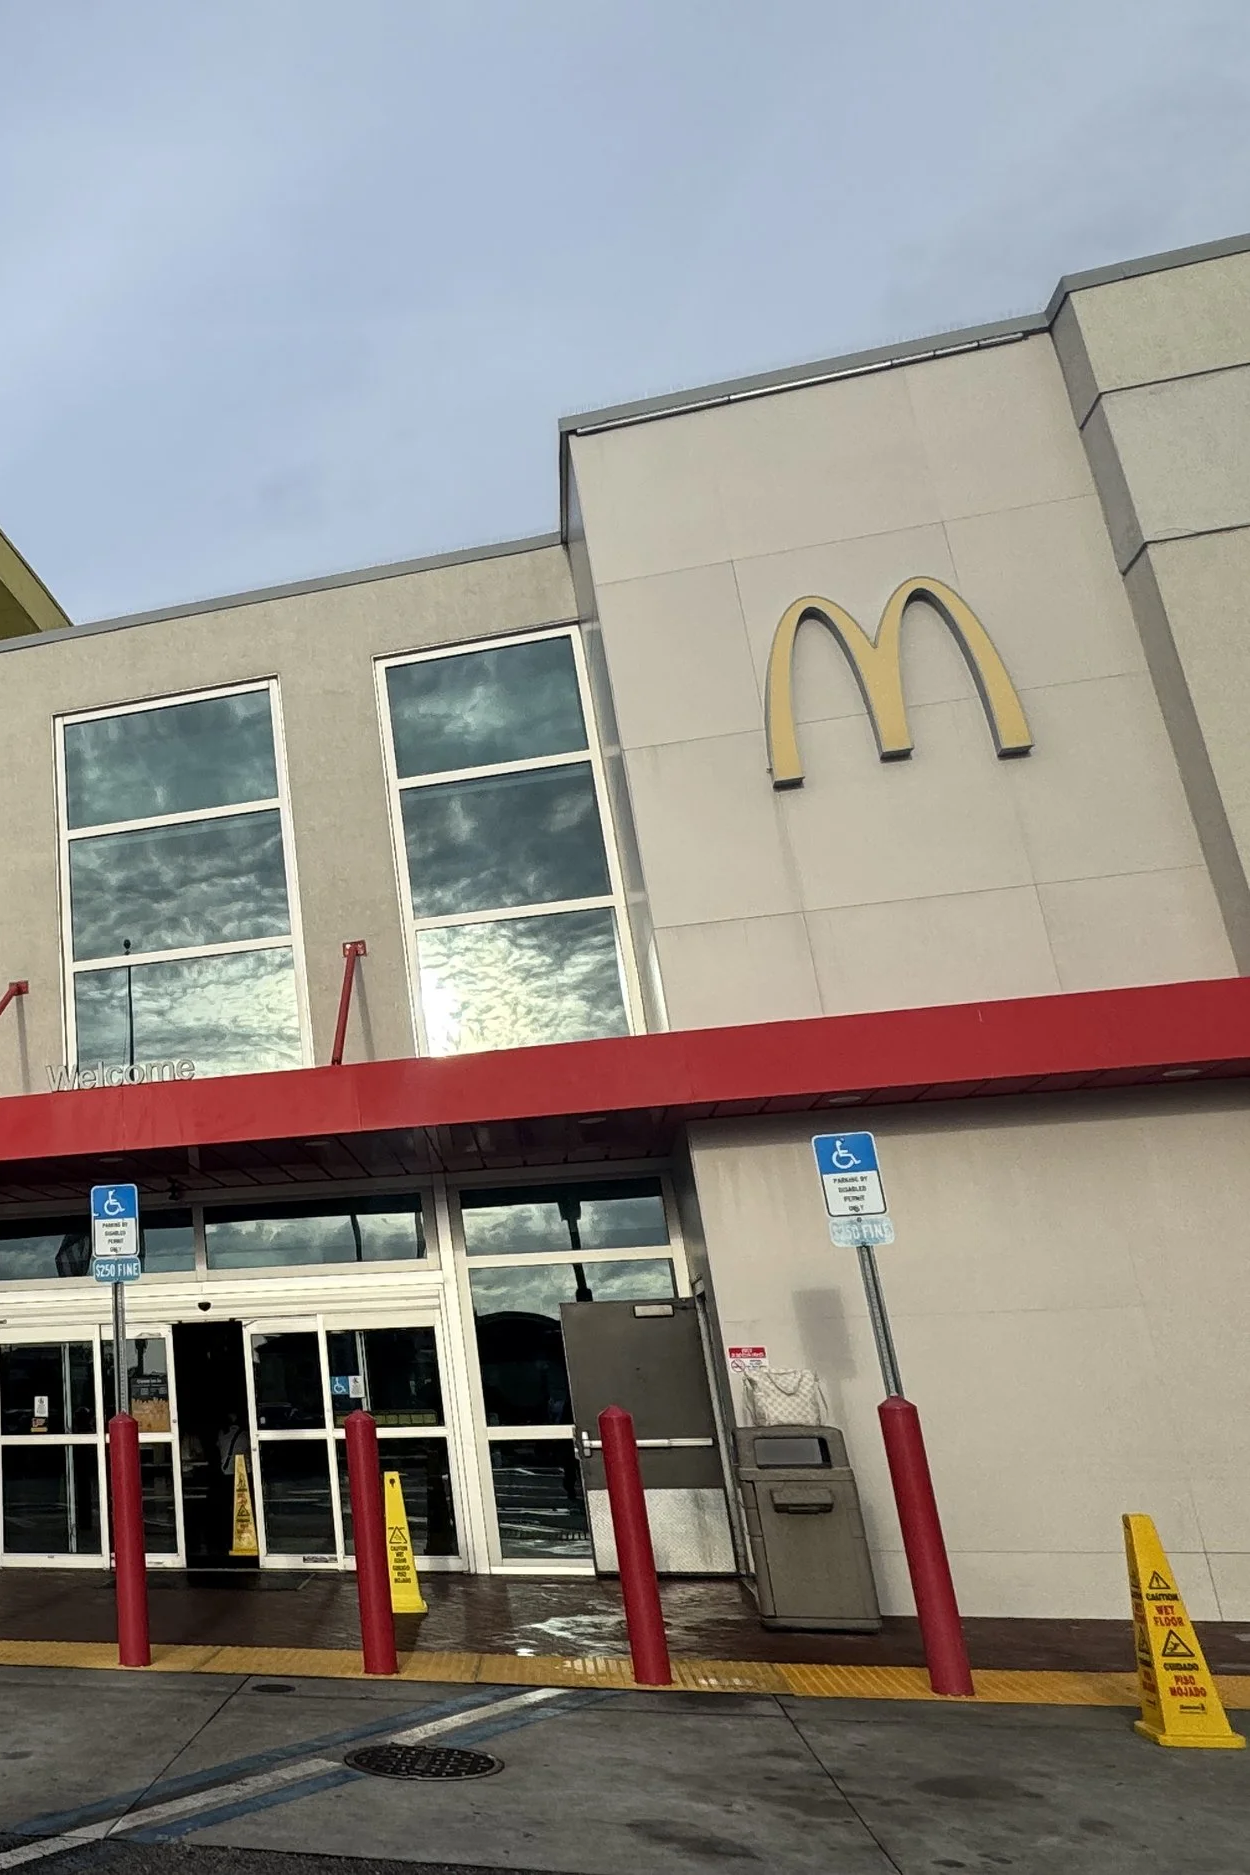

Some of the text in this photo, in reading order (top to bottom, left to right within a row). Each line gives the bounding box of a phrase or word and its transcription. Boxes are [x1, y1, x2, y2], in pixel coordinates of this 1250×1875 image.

[766, 575, 1032, 790] M
[45, 1058, 196, 1093] Welcome
[95, 1262, 139, 1278] $250 FINE
[1146, 1592, 1180, 1601] CAUTION
[1155, 1605, 1175, 1615] WET
[1153, 1616, 1185, 1627] FLOOR
[1163, 1662, 1200, 1672] CUIDADO
[1173, 1674, 1196, 1686] PISO
[1168, 1686, 1207, 1698] MOJADO
